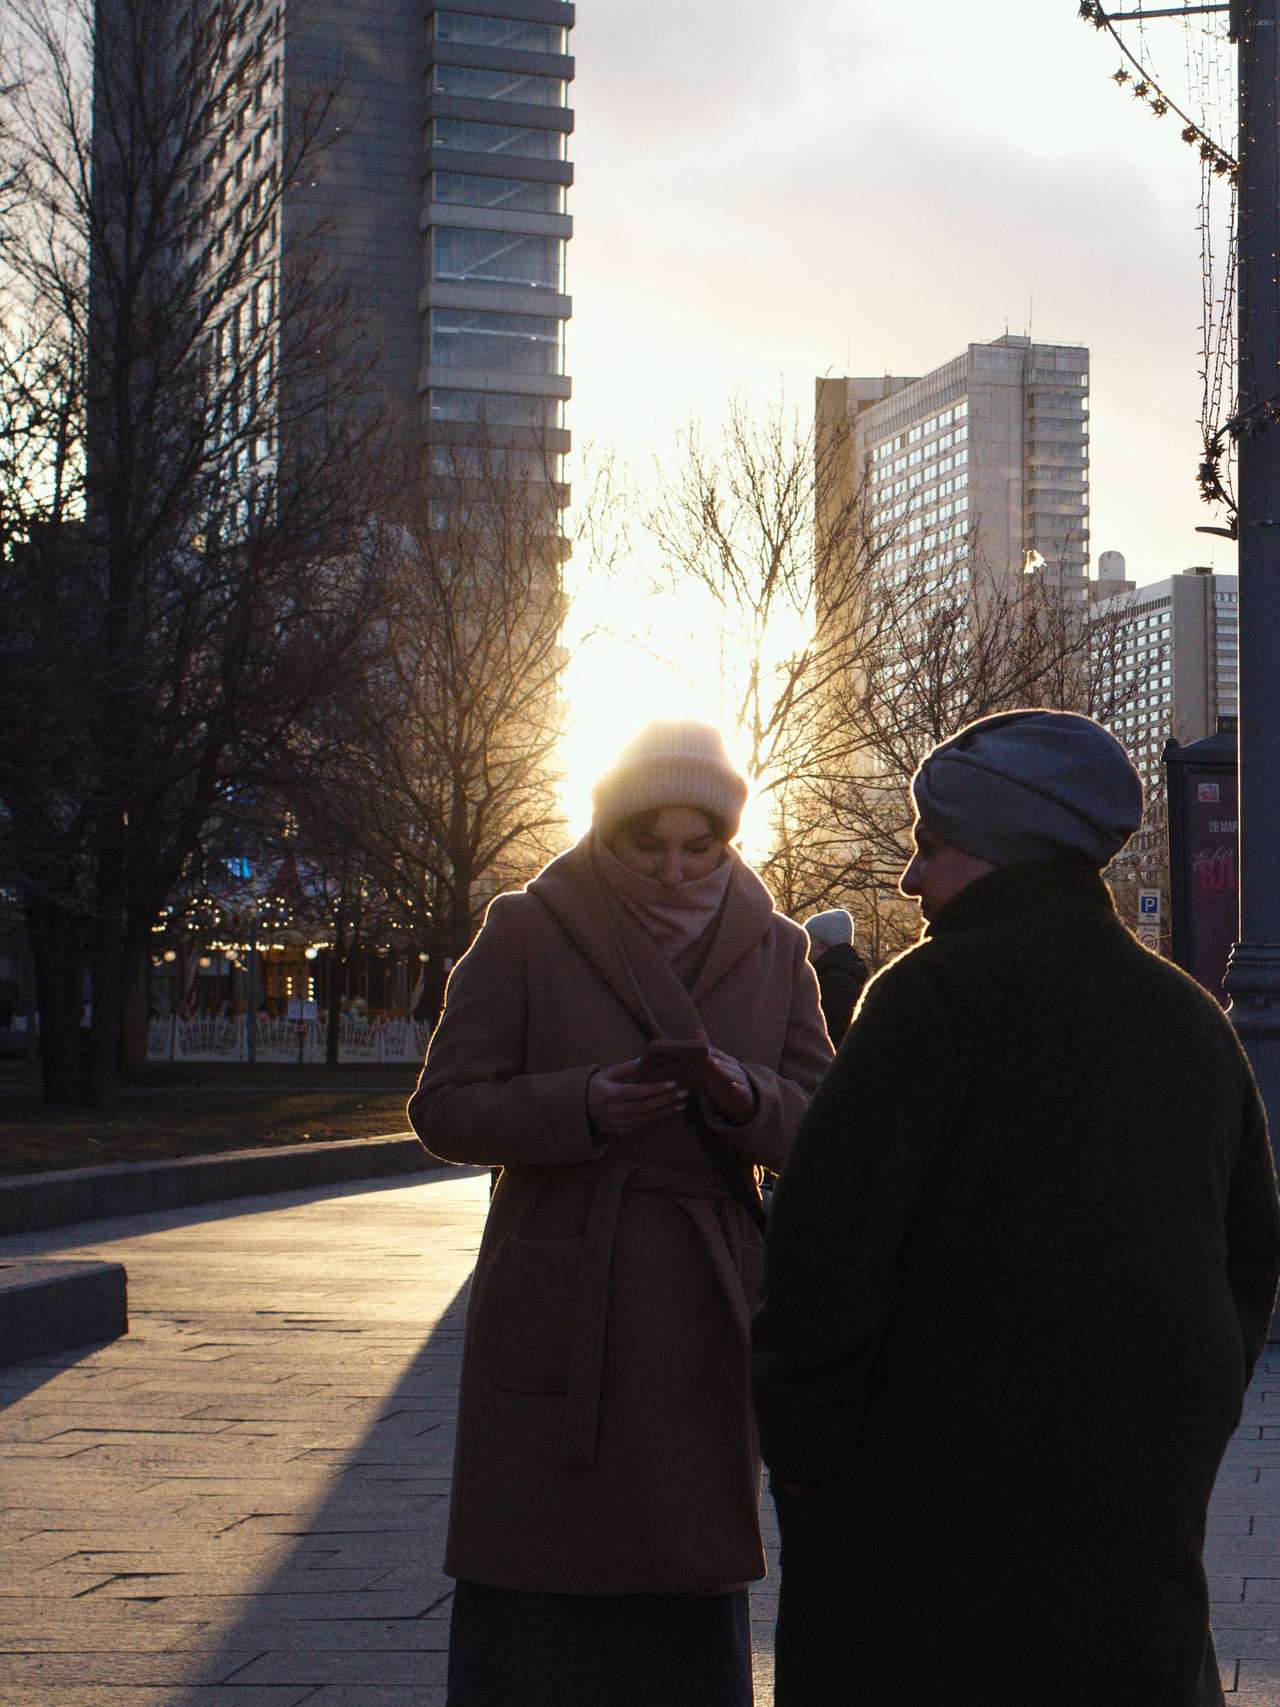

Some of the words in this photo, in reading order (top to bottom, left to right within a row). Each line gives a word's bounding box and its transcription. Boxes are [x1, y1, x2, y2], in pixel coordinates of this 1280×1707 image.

[1209, 821, 1218, 833] 28
[1220, 821, 1239, 833] МАР
[1145, 898, 1155, 911] P
